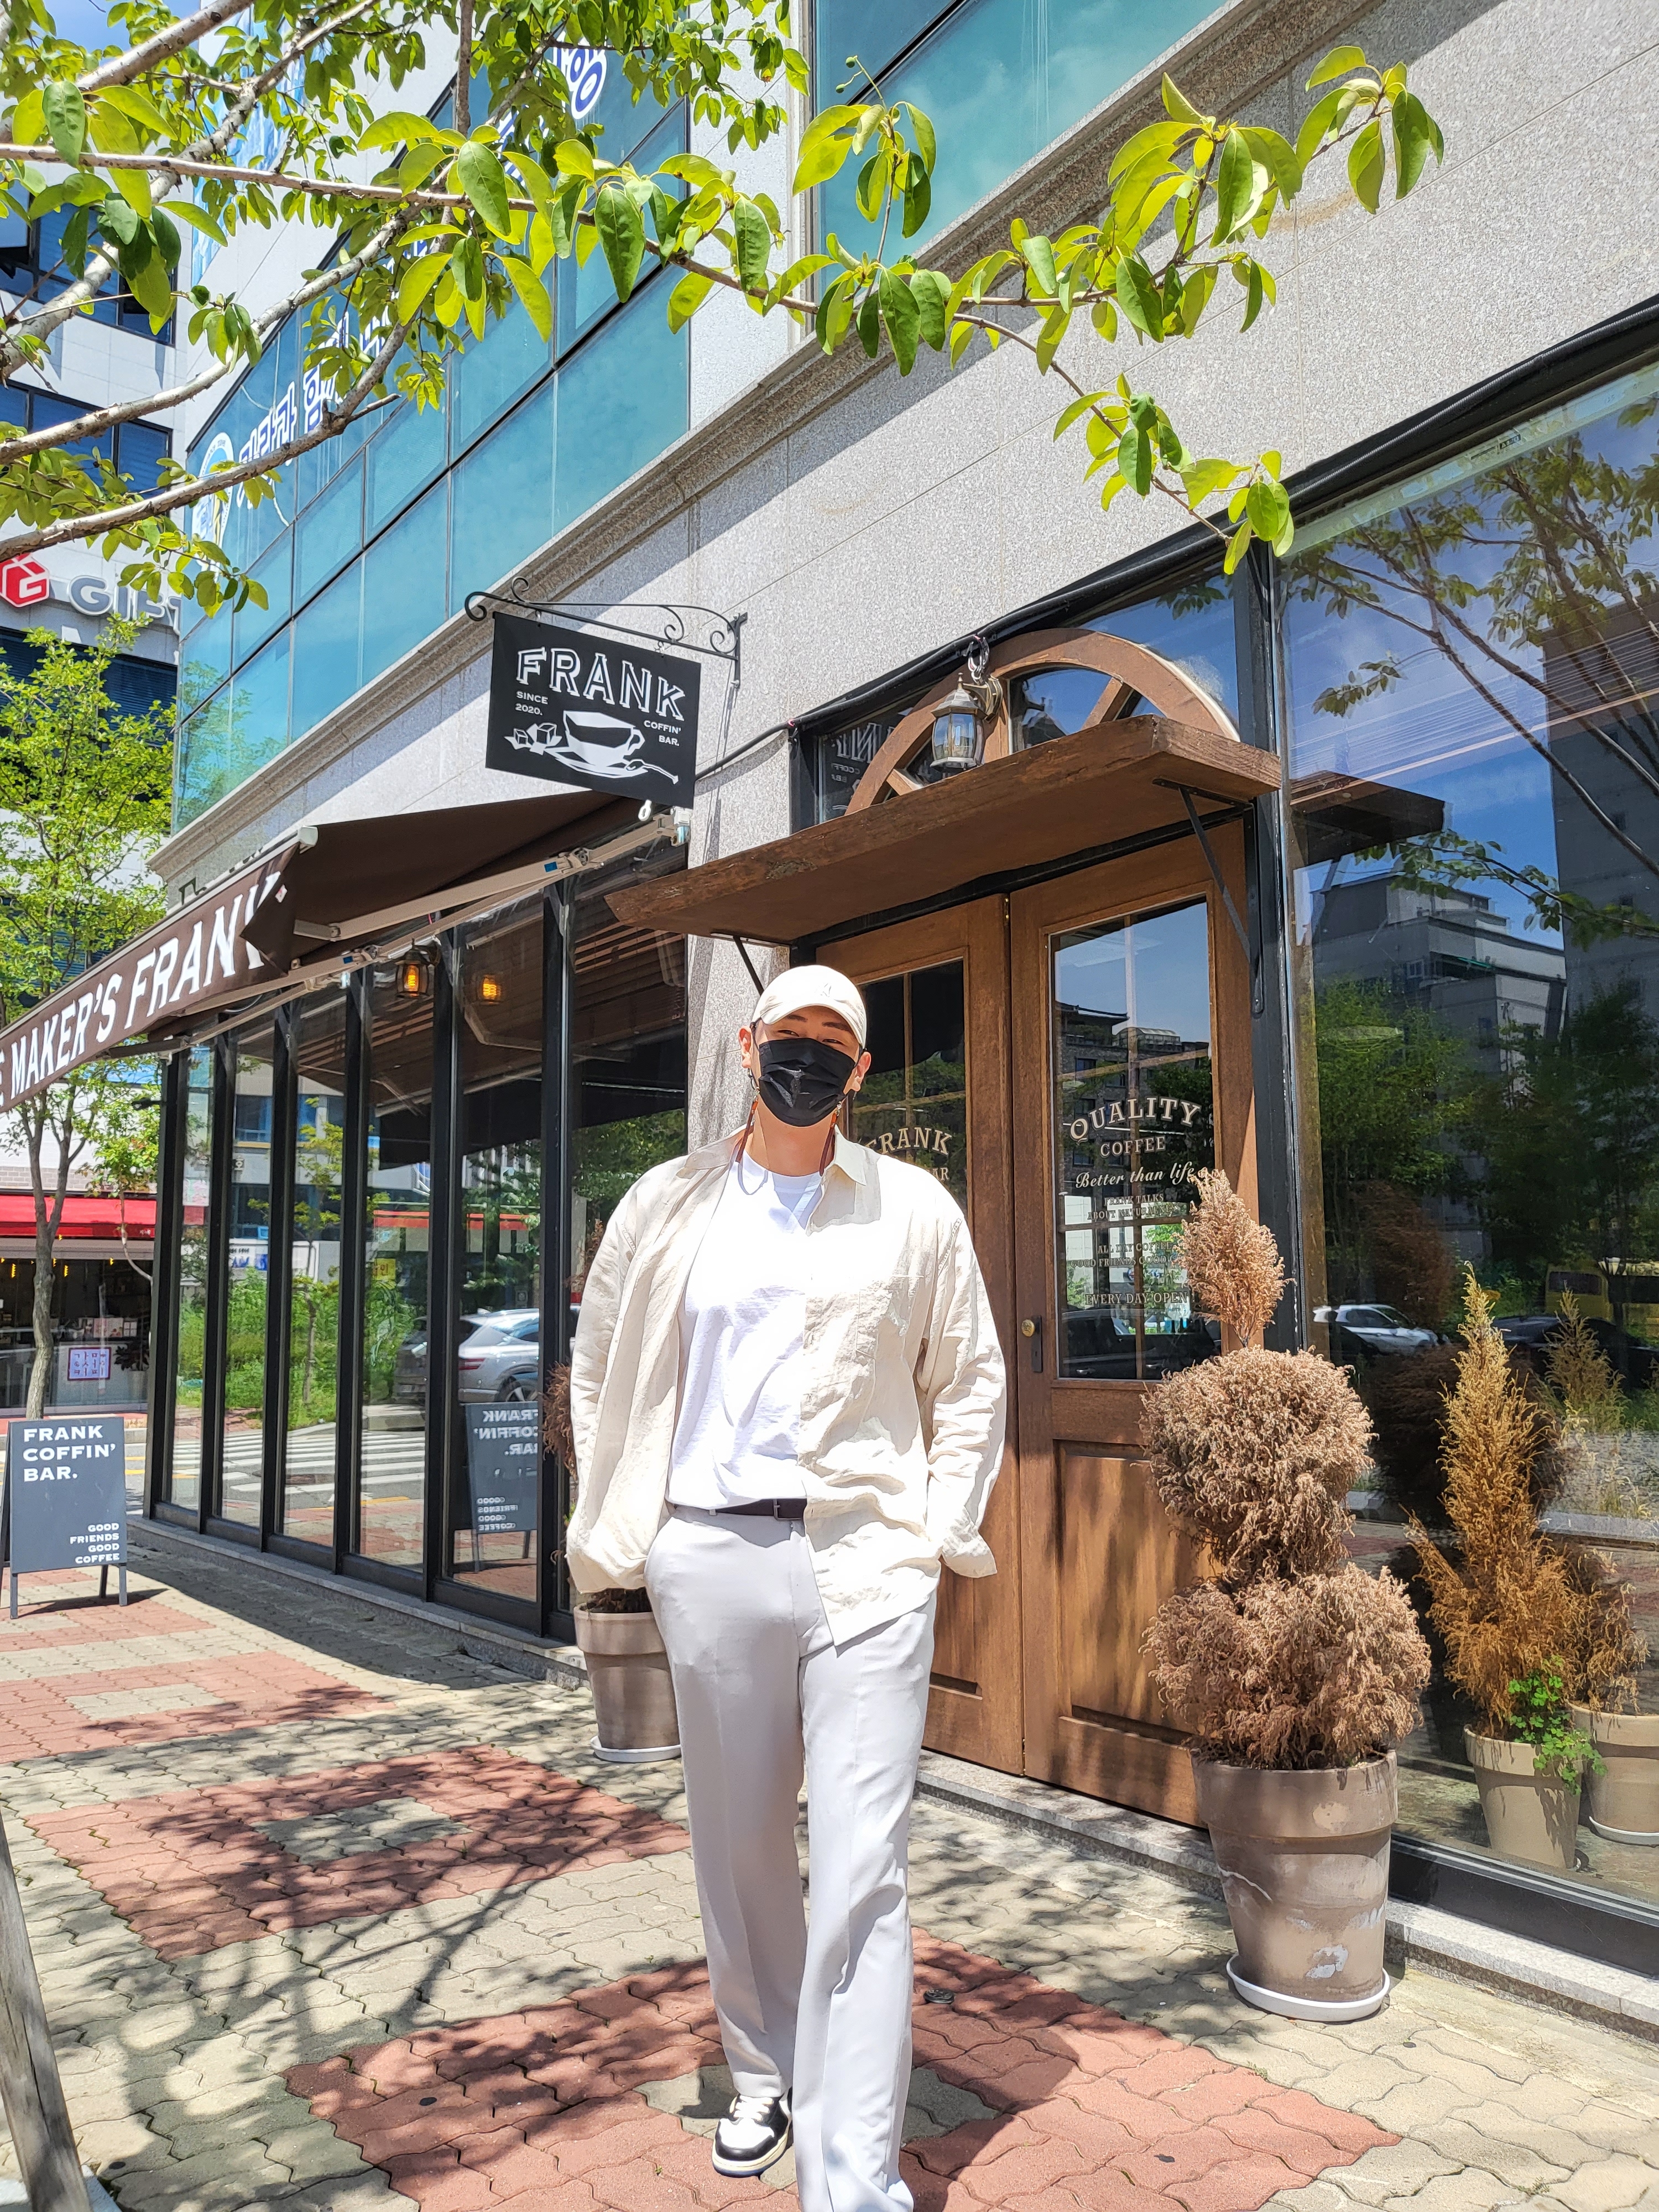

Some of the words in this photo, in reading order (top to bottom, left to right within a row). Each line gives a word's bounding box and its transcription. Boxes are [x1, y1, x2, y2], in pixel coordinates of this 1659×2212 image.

[516, 647, 685, 721] FRANK
[517, 691, 548, 705] SINCE
[515, 703, 543, 716] 2020.
[643, 720, 681, 734] COFFIN'
[659, 735, 680, 747] BAR.
[11, 972, 123, 1100] MAKER'S
[1070, 1097, 1200, 1146] QUALITY
[1100, 1136, 1166, 1157] COFFEE
[1075, 1172, 1125, 1188] Better
[1130, 1166, 1165, 1183] than
[1170, 1161, 1194, 1185] life
[1104, 1196, 1134, 1206] FRANK
[1136, 1193, 1164, 1203] TALKS
[1087, 1210, 1116, 1220] ABOUT
[1118, 1203, 1181, 1218] NATURALNESS
[1098, 1244, 1114, 1254] ALL
[1115, 1243, 1134, 1253] DAY
[1135, 1241, 1172, 1251] COFFEE
[1071, 1259, 1096, 1268] GOOD
[1099, 1257, 1136, 1267] FRIENDS
[1139, 1255, 1166, 1265] GOOD
[1085, 1293, 1122, 1305] EVERY
[1126, 1292, 1152, 1305] DAY
[1154, 1292, 1187, 1303] OPEN
[23, 1425, 103, 1442] FRANK
[23, 1443, 116, 1462] COFFIN'
[23, 1466, 78, 1483] BAR.
[87, 1522, 119, 1532] GOOD
[70, 1533, 119, 1545] FRIENDS
[88, 1543, 120, 1553] GOOD
[75, 1553, 121, 1564] COFFEE
